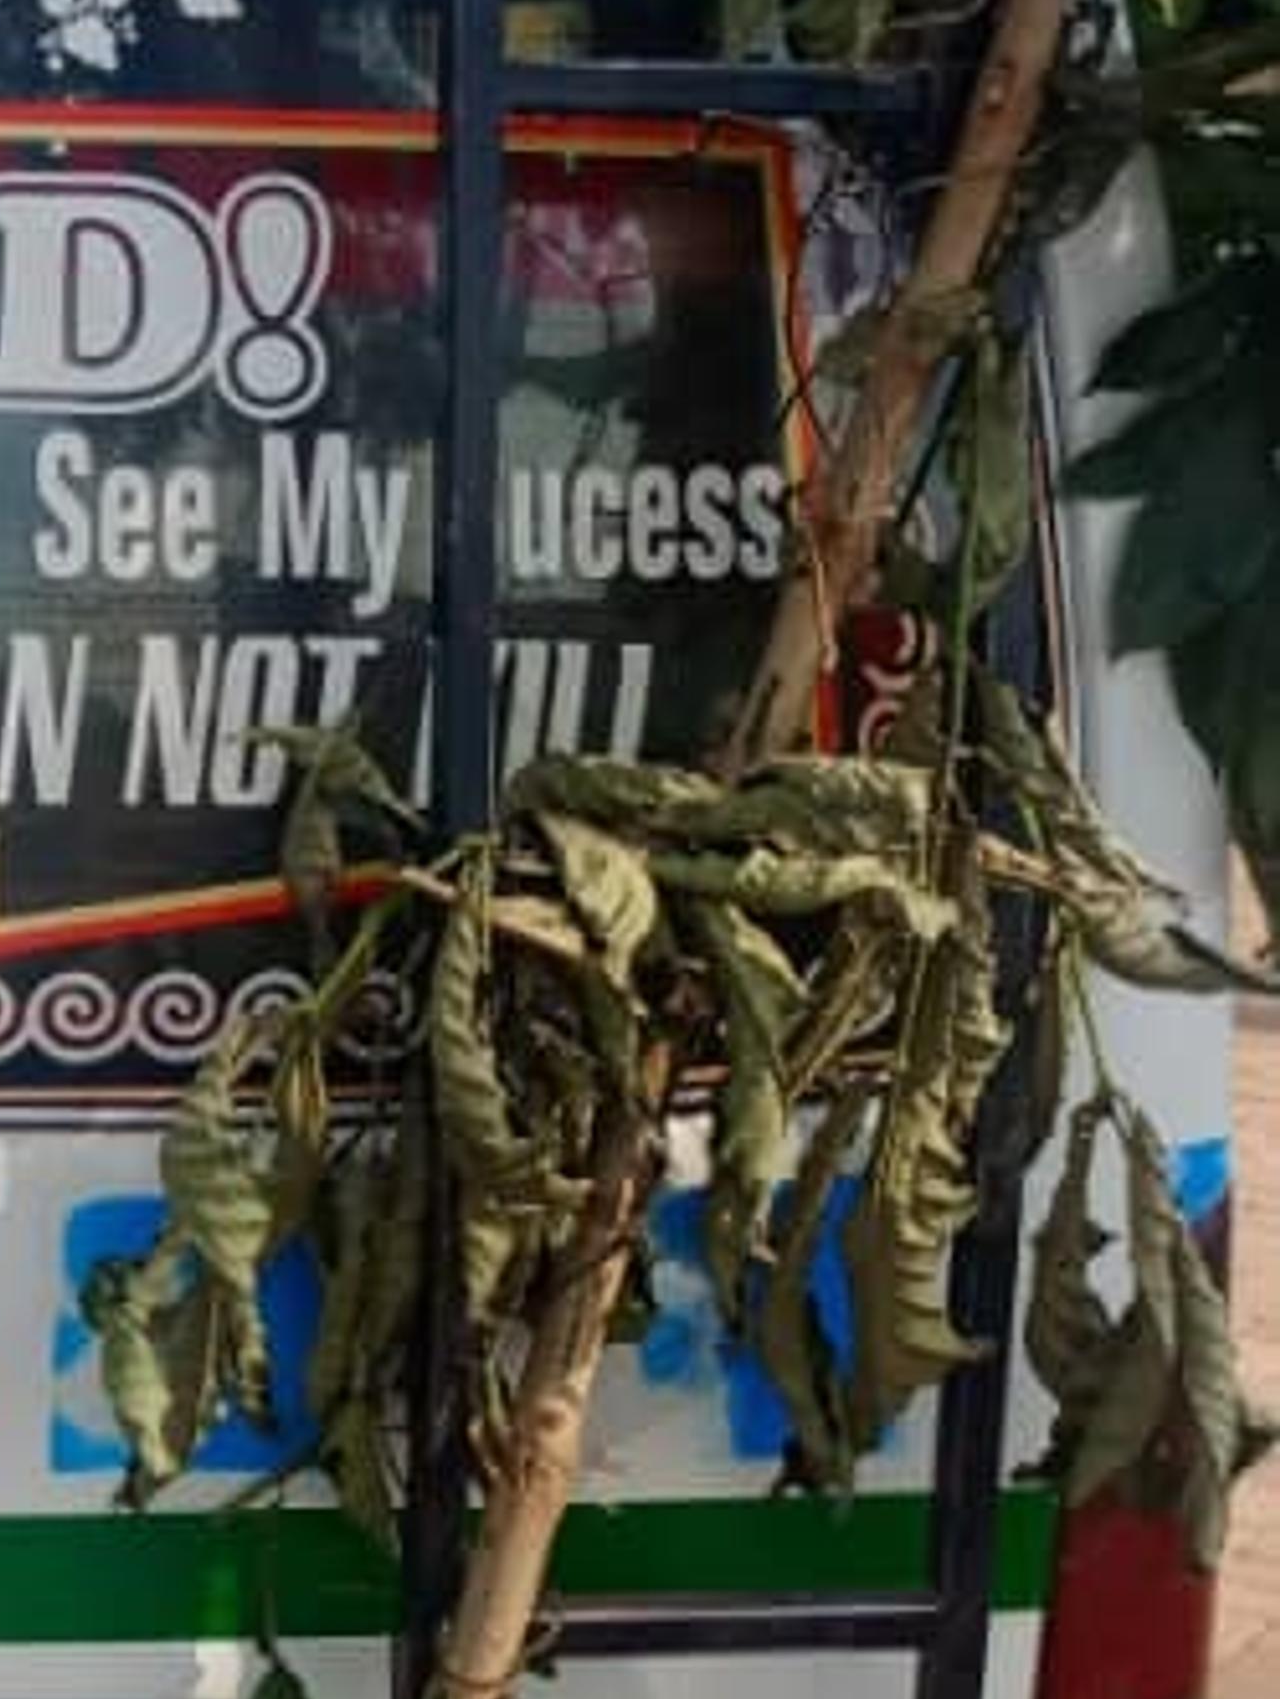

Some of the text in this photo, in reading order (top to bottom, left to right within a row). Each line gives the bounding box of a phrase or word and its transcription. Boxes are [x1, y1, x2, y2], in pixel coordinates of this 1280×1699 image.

[34, 428, 218, 582] See
[256, 430, 410, 620] My
[510, 462, 784, 582] ucess
[122, 634, 382, 808] NOT
[412, 638, 654, 810] ILL
